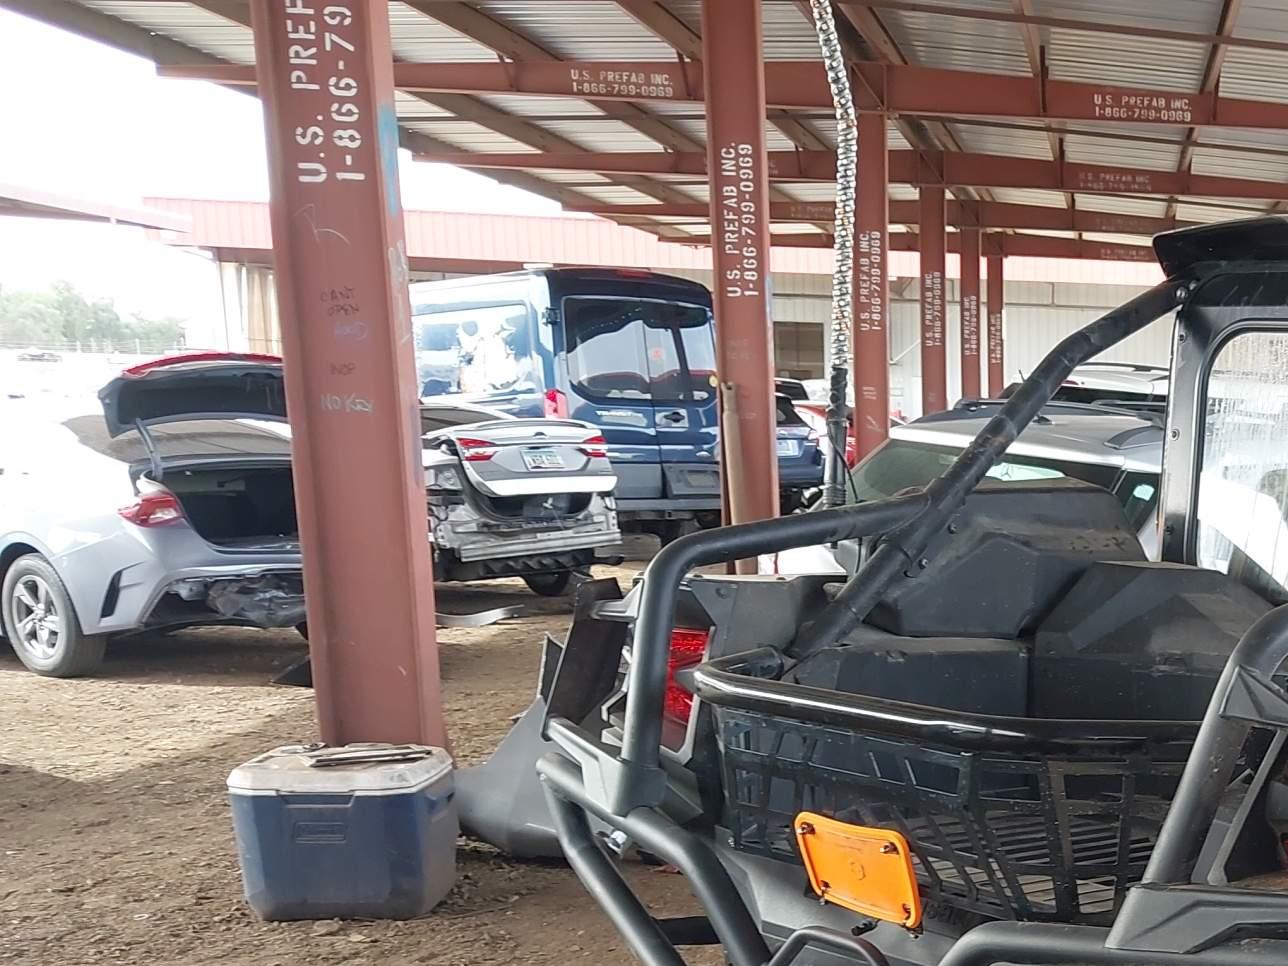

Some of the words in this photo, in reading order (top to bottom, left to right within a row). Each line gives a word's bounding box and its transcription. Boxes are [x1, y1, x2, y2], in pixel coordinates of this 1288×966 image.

[323, 6, 365, 181] 1-866-79
[570, 69, 593, 81] U.S.
[600, 71, 645, 84] PREFAB
[650, 74, 673, 86] INC.
[572, 82, 673, 97] 1-866-799-0969
[1095, 107, 1192, 123] 1-866-799-0969
[1121, 96, 1166, 109] PREFAB
[1170, 99, 1192, 111] INC.
[295, 115, 328, 183] U.S.
[721, 142, 737, 176] INC.
[722, 186, 740, 254] PREFAB
[737, 144, 759, 297] 1-866-799-0969
[859, 230, 870, 254] INC.
[726, 264, 742, 297] U.S.
[859, 257, 870, 304] PREFAB
